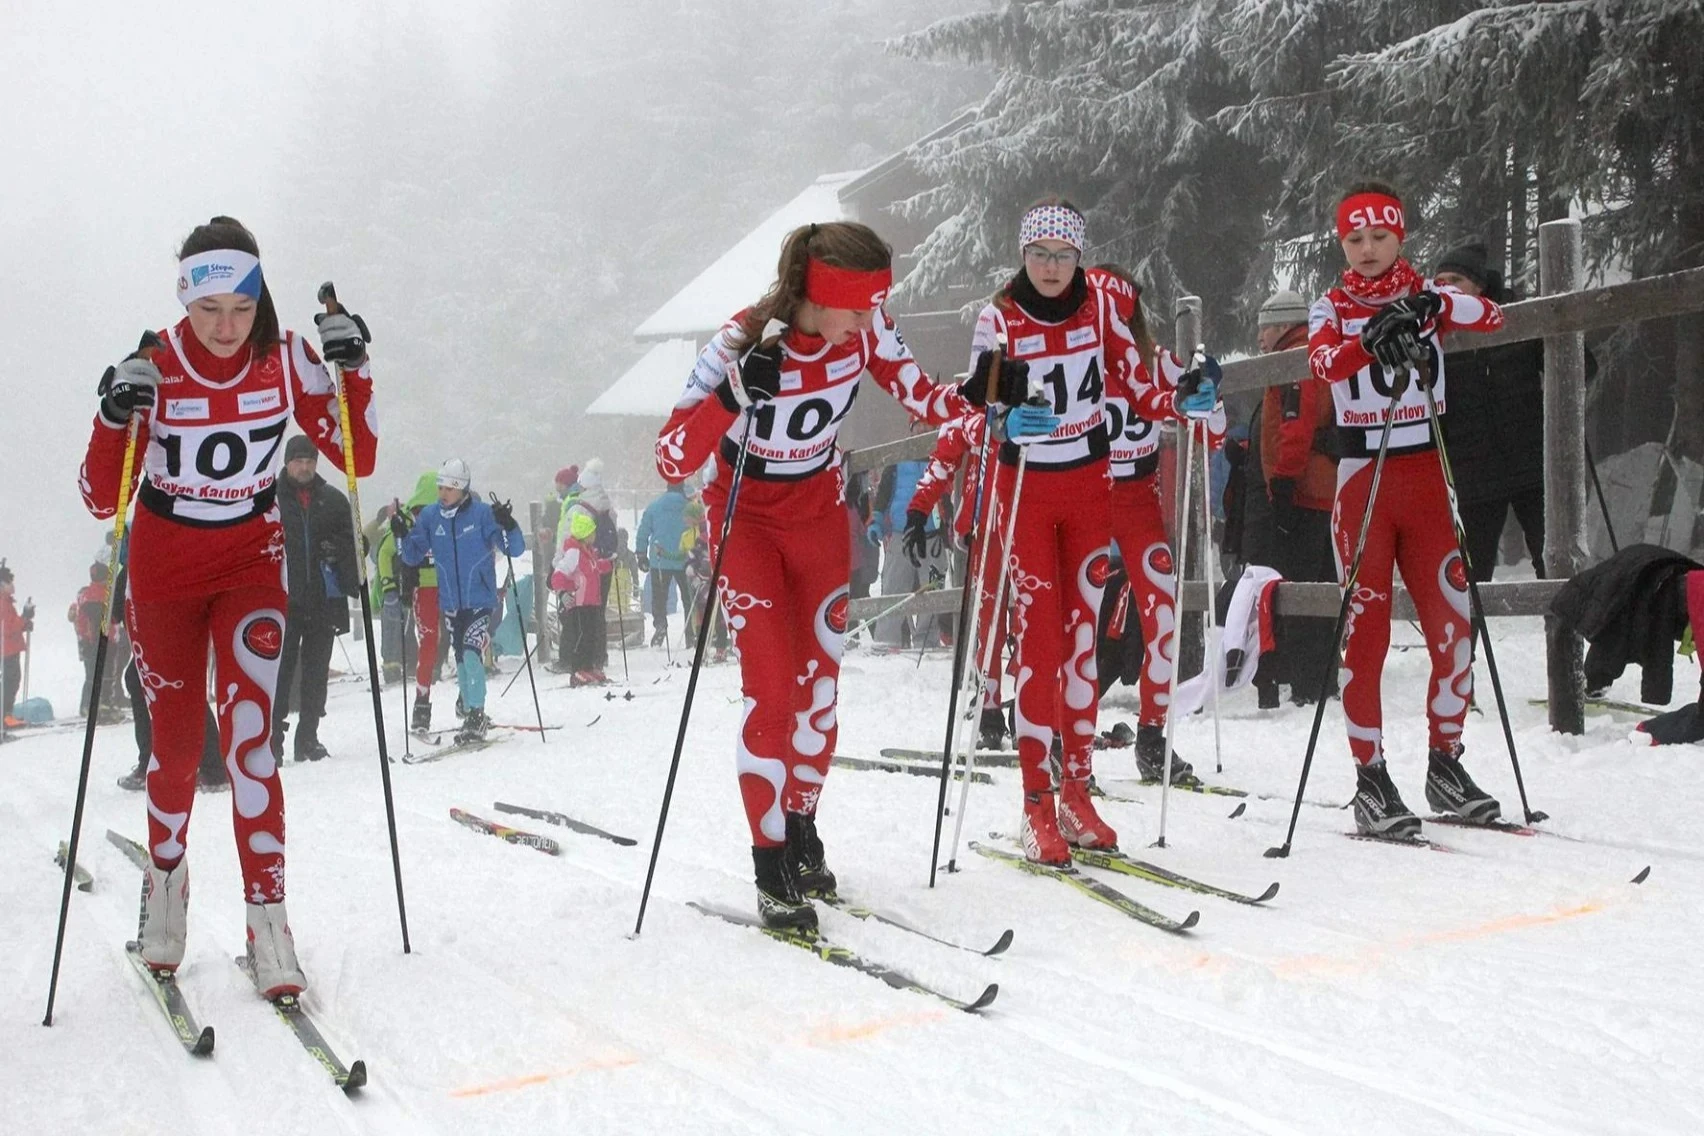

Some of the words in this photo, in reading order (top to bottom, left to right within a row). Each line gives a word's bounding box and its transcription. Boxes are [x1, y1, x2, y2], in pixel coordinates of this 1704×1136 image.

[1085, 273, 1133, 299] VAN
[1042, 355, 1104, 416] 14
[1105, 402, 1153, 441] 05
[157, 416, 288, 481] 107
